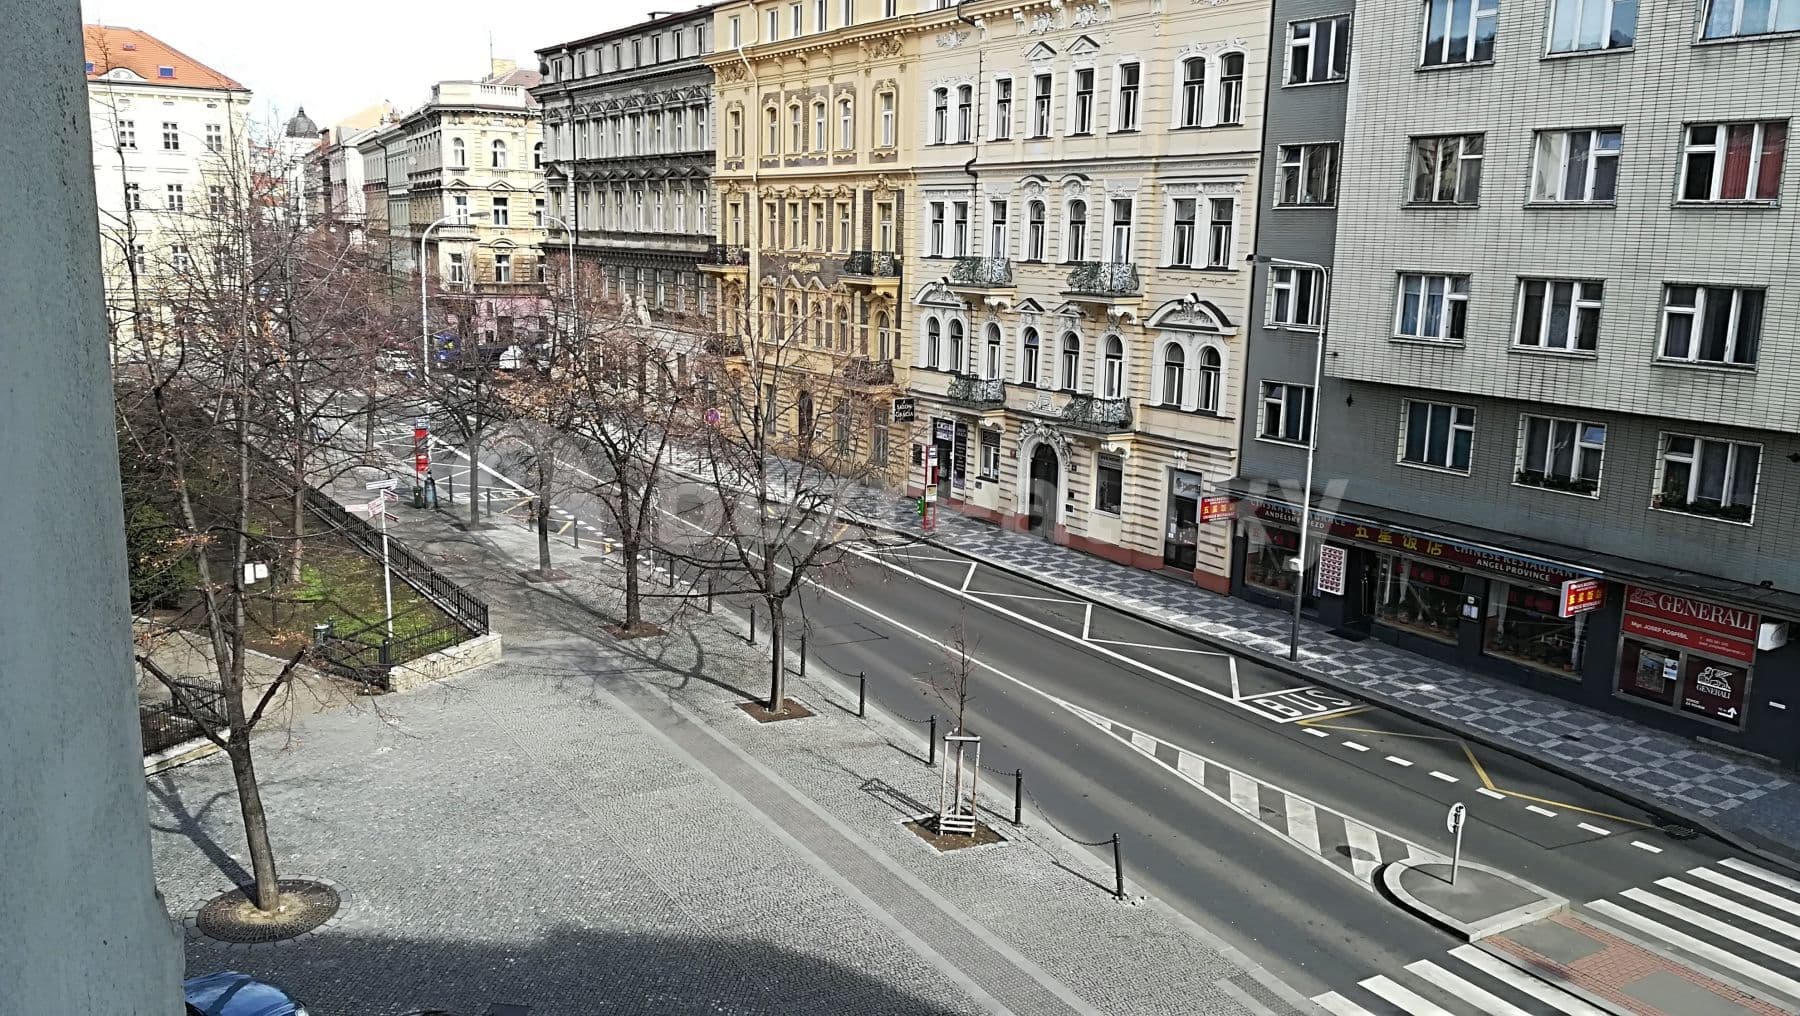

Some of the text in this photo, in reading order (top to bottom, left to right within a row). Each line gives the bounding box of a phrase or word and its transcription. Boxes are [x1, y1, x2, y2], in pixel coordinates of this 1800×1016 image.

[1476, 558, 1550, 583] ANGEL PROVINCE
[1659, 594, 1754, 631] GENERALI
[1252, 690, 1352, 717] BUS
[1696, 684, 1731, 699] GENERALI
